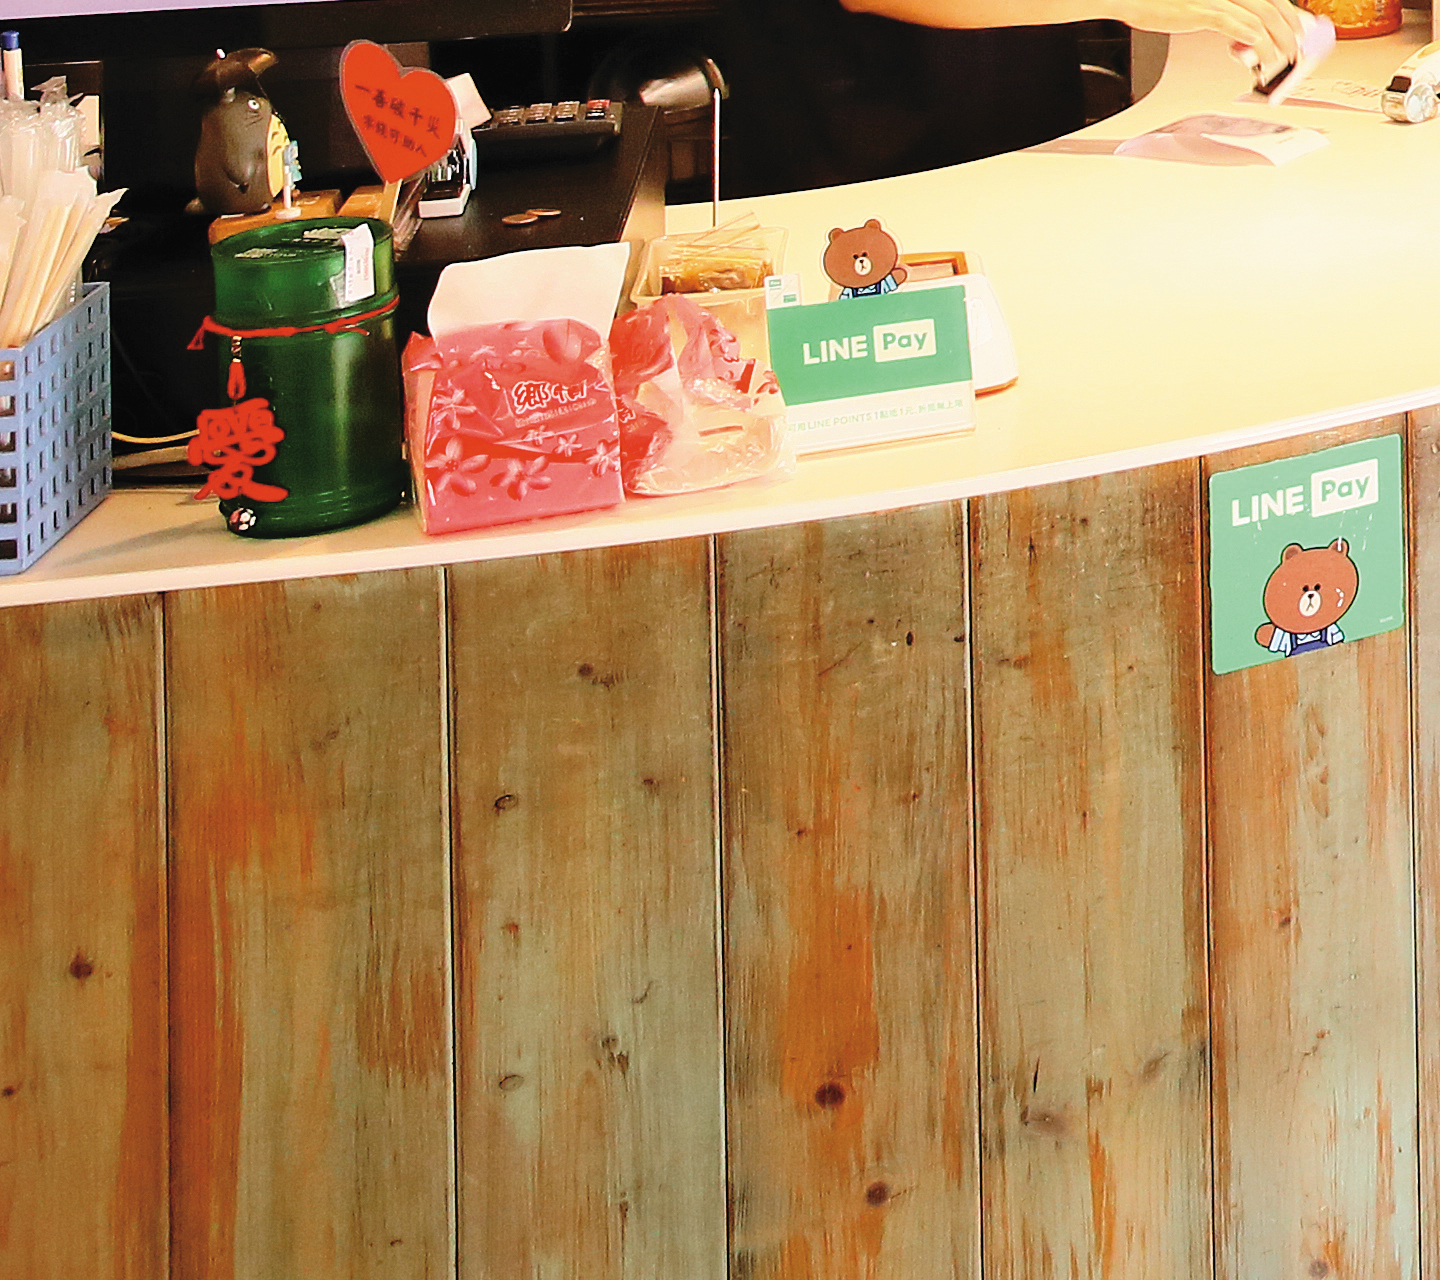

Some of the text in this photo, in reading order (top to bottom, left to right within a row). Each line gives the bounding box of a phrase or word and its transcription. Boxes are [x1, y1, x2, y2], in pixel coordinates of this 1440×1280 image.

[802, 332, 928, 365] LINE Pay
[1231, 476, 1370, 527] LINE Pay
